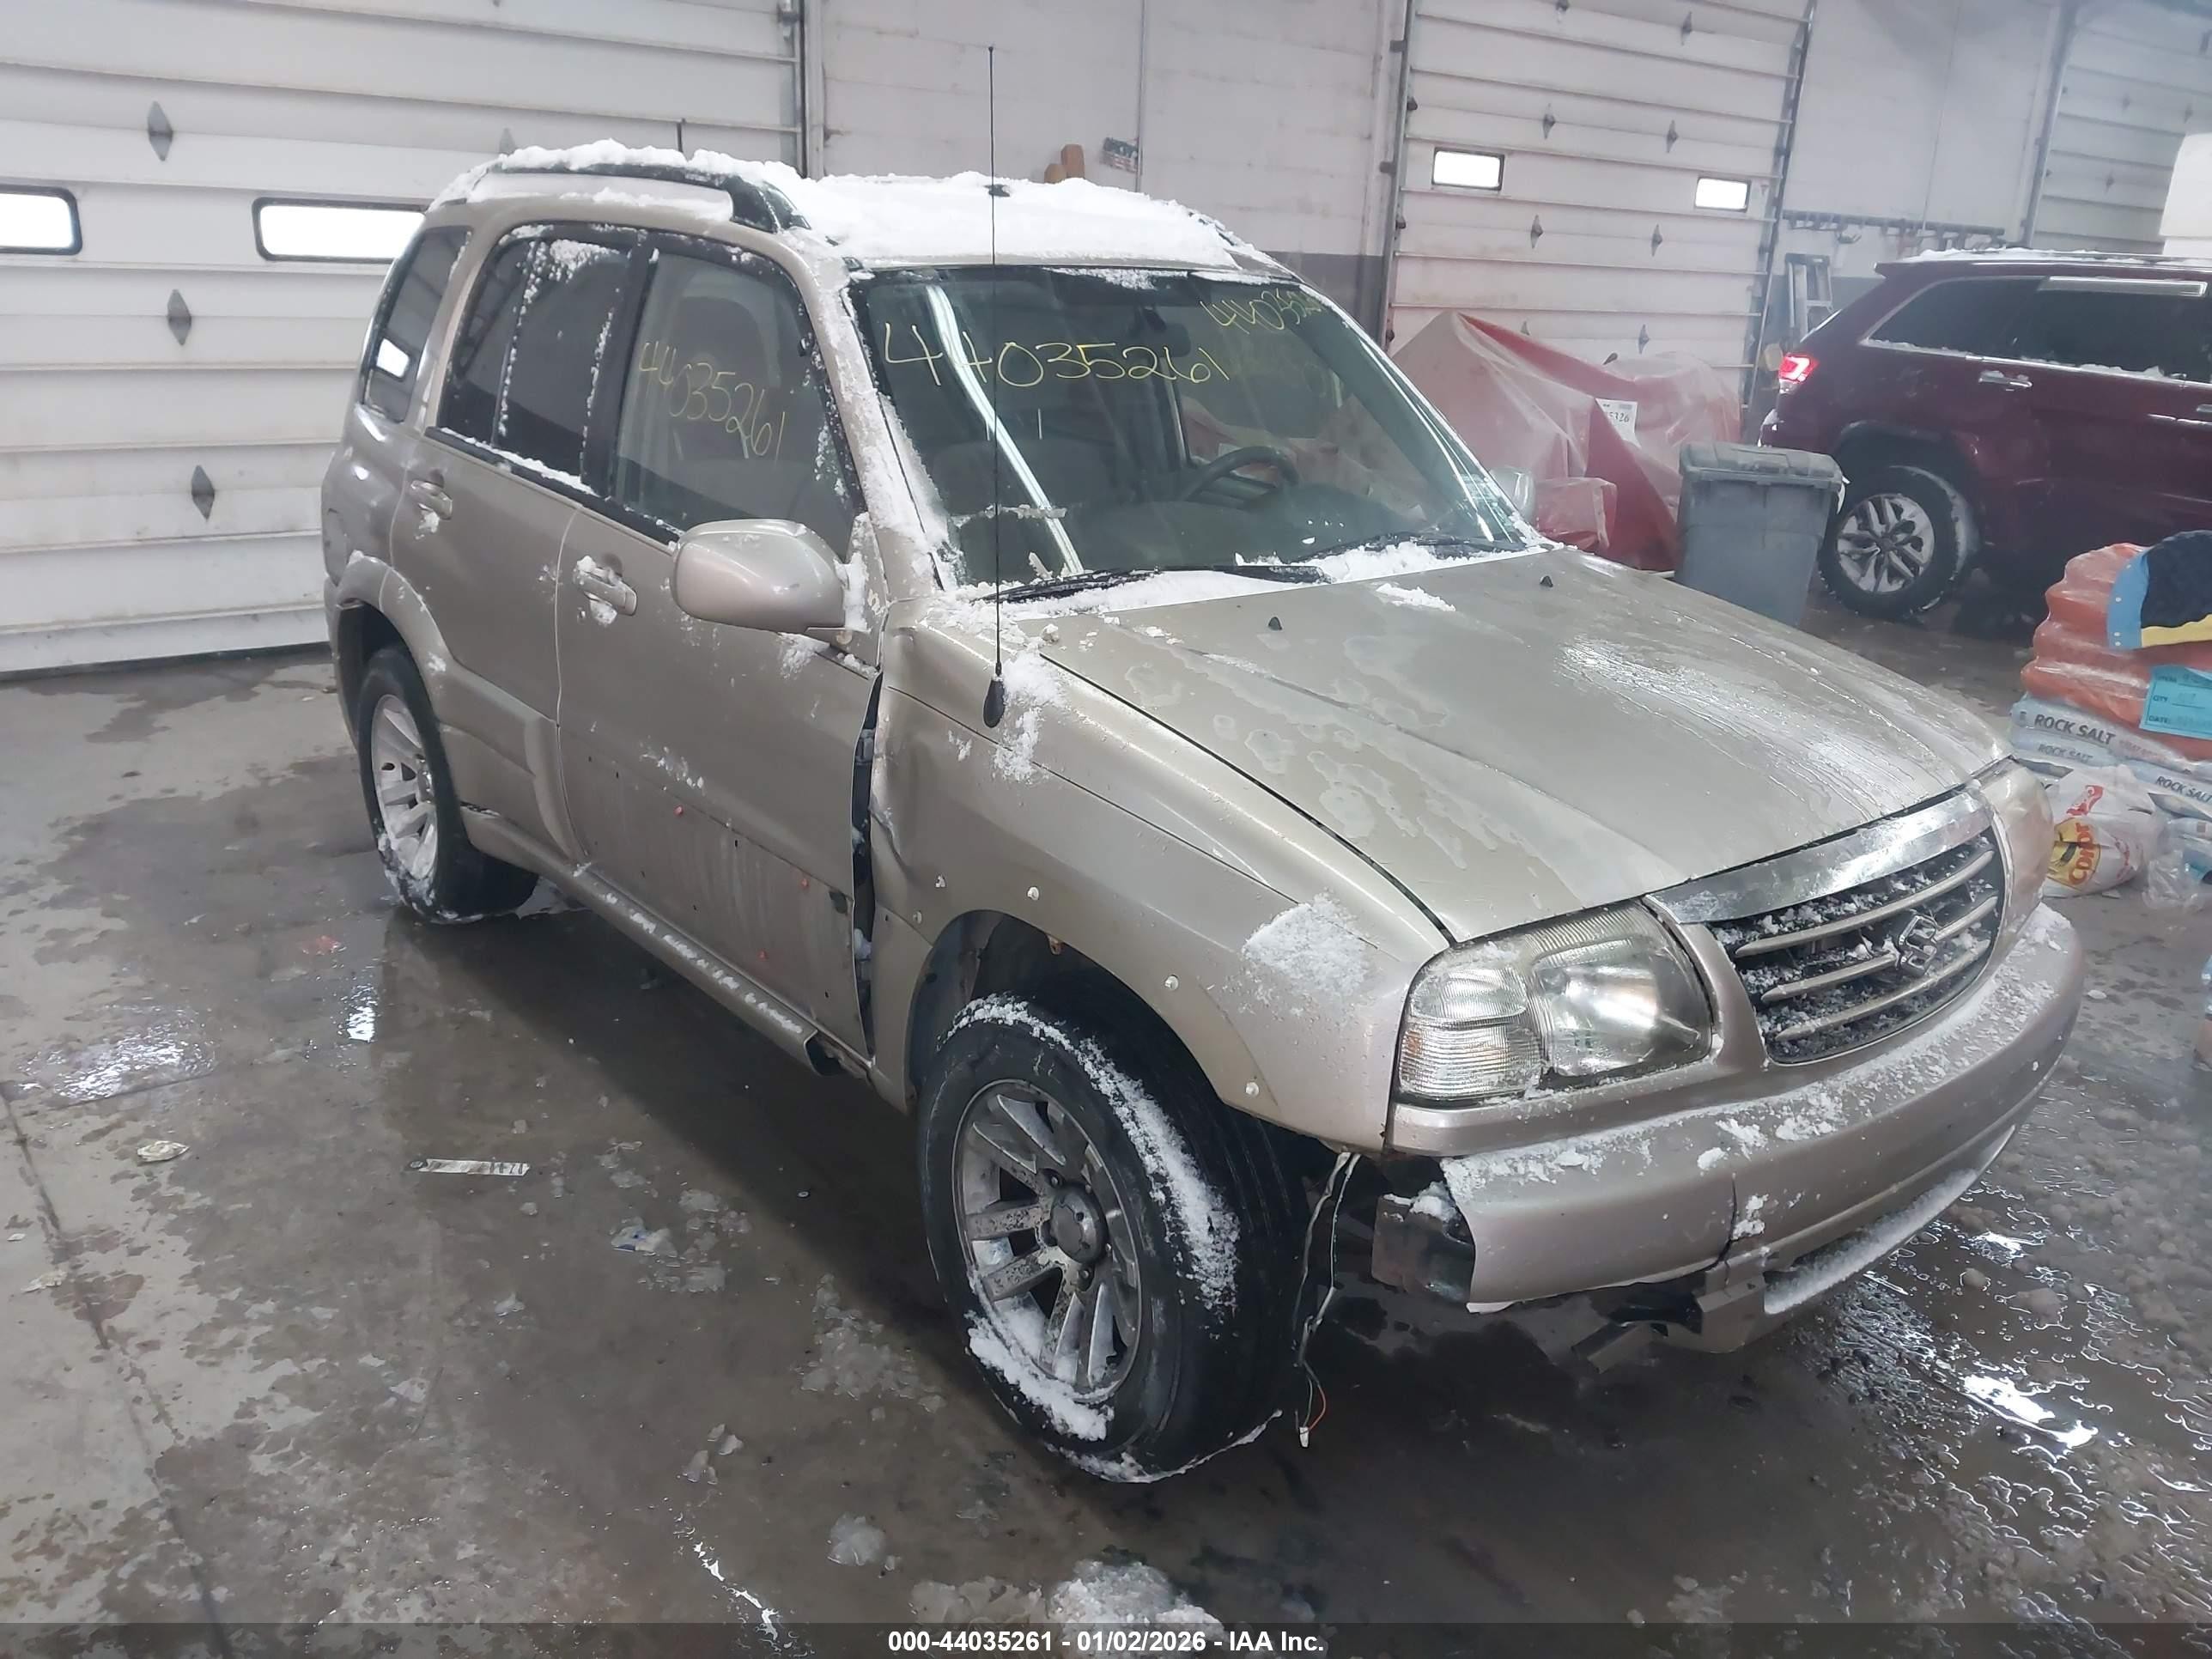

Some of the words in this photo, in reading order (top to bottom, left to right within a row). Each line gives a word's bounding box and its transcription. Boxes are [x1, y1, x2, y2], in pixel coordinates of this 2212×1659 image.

[884, 322, 1230, 386] 44035261
[639, 340, 786, 467] 44035261
[2034, 714, 2075, 734] ROCK
[2076, 725, 2116, 745] SALT
[2038, 744, 2069, 758] ROCK
[2069, 750, 2093, 763] SALT
[2155, 775, 2186, 794] ROCK
[2186, 787, 2212, 803] SALT
